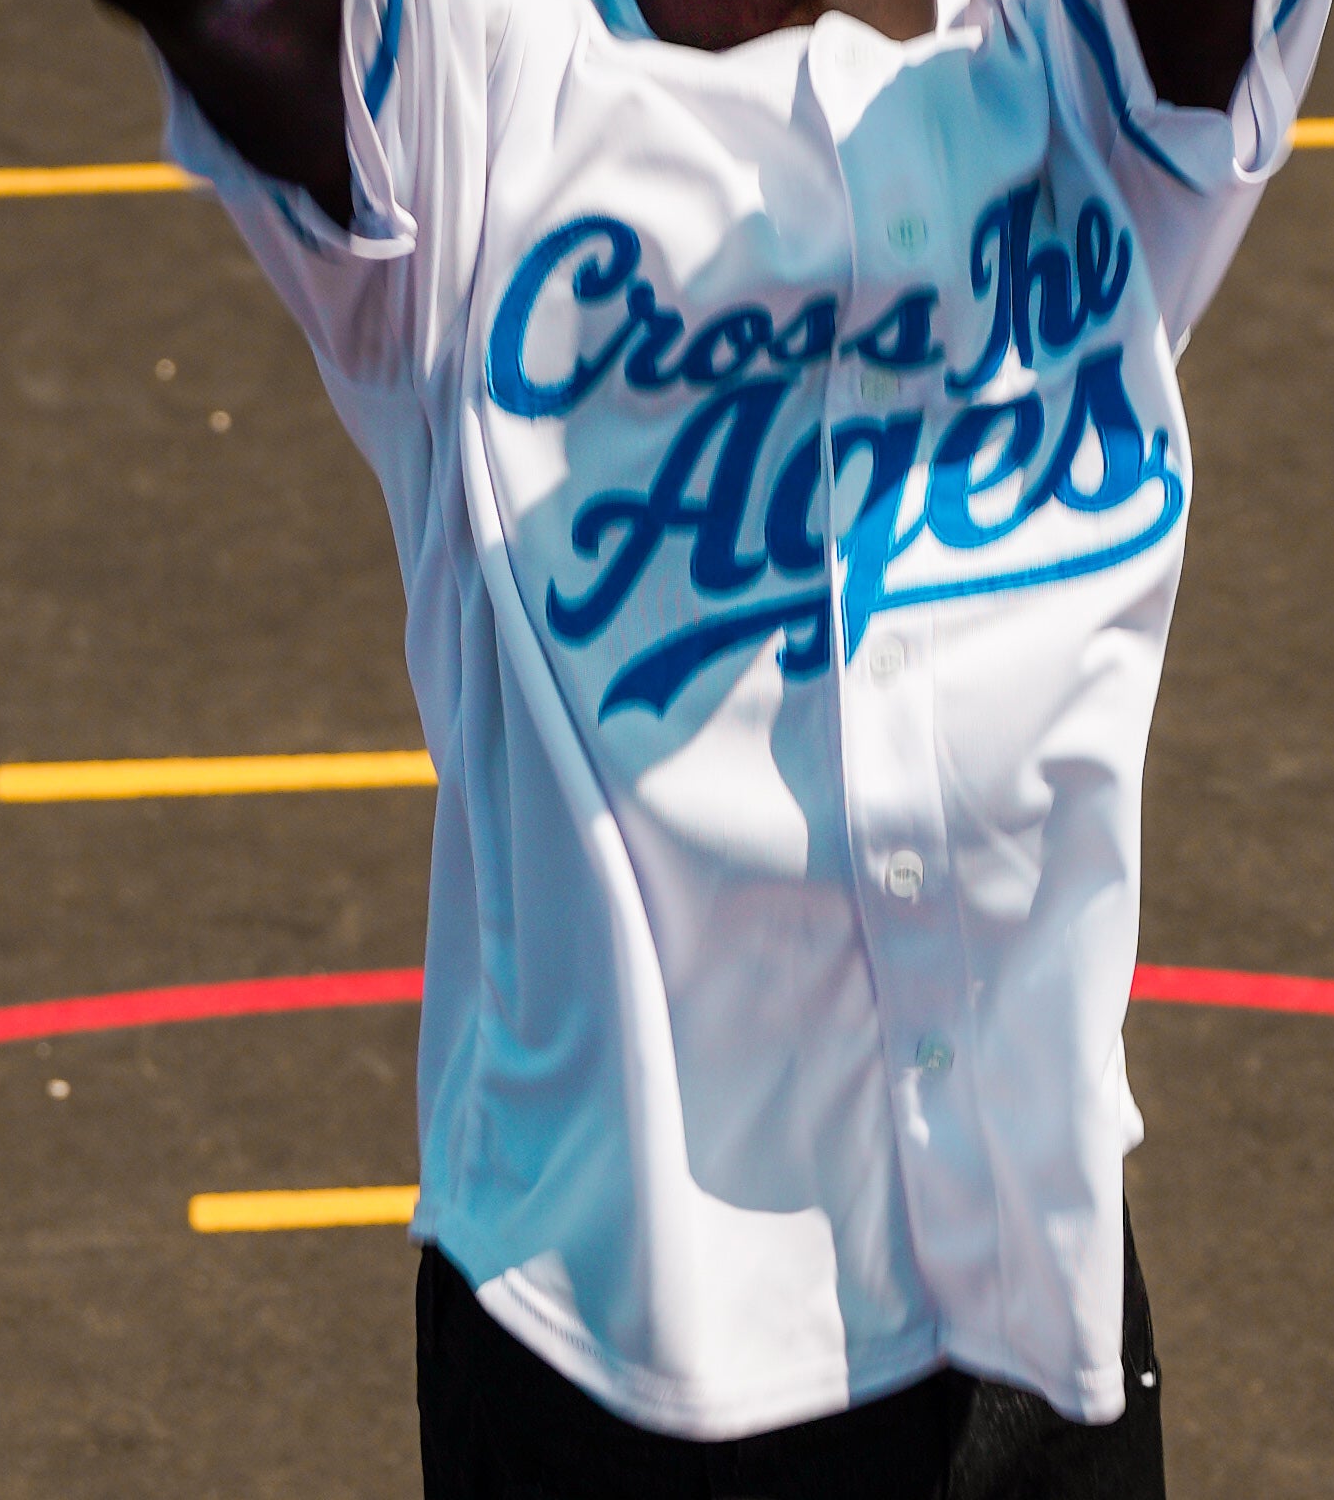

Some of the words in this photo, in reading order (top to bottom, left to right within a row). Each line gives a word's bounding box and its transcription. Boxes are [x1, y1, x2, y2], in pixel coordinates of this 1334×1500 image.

[485, 215, 945, 417] Cross
[946, 181, 1132, 393] The
[545, 346, 1184, 726] Ages
